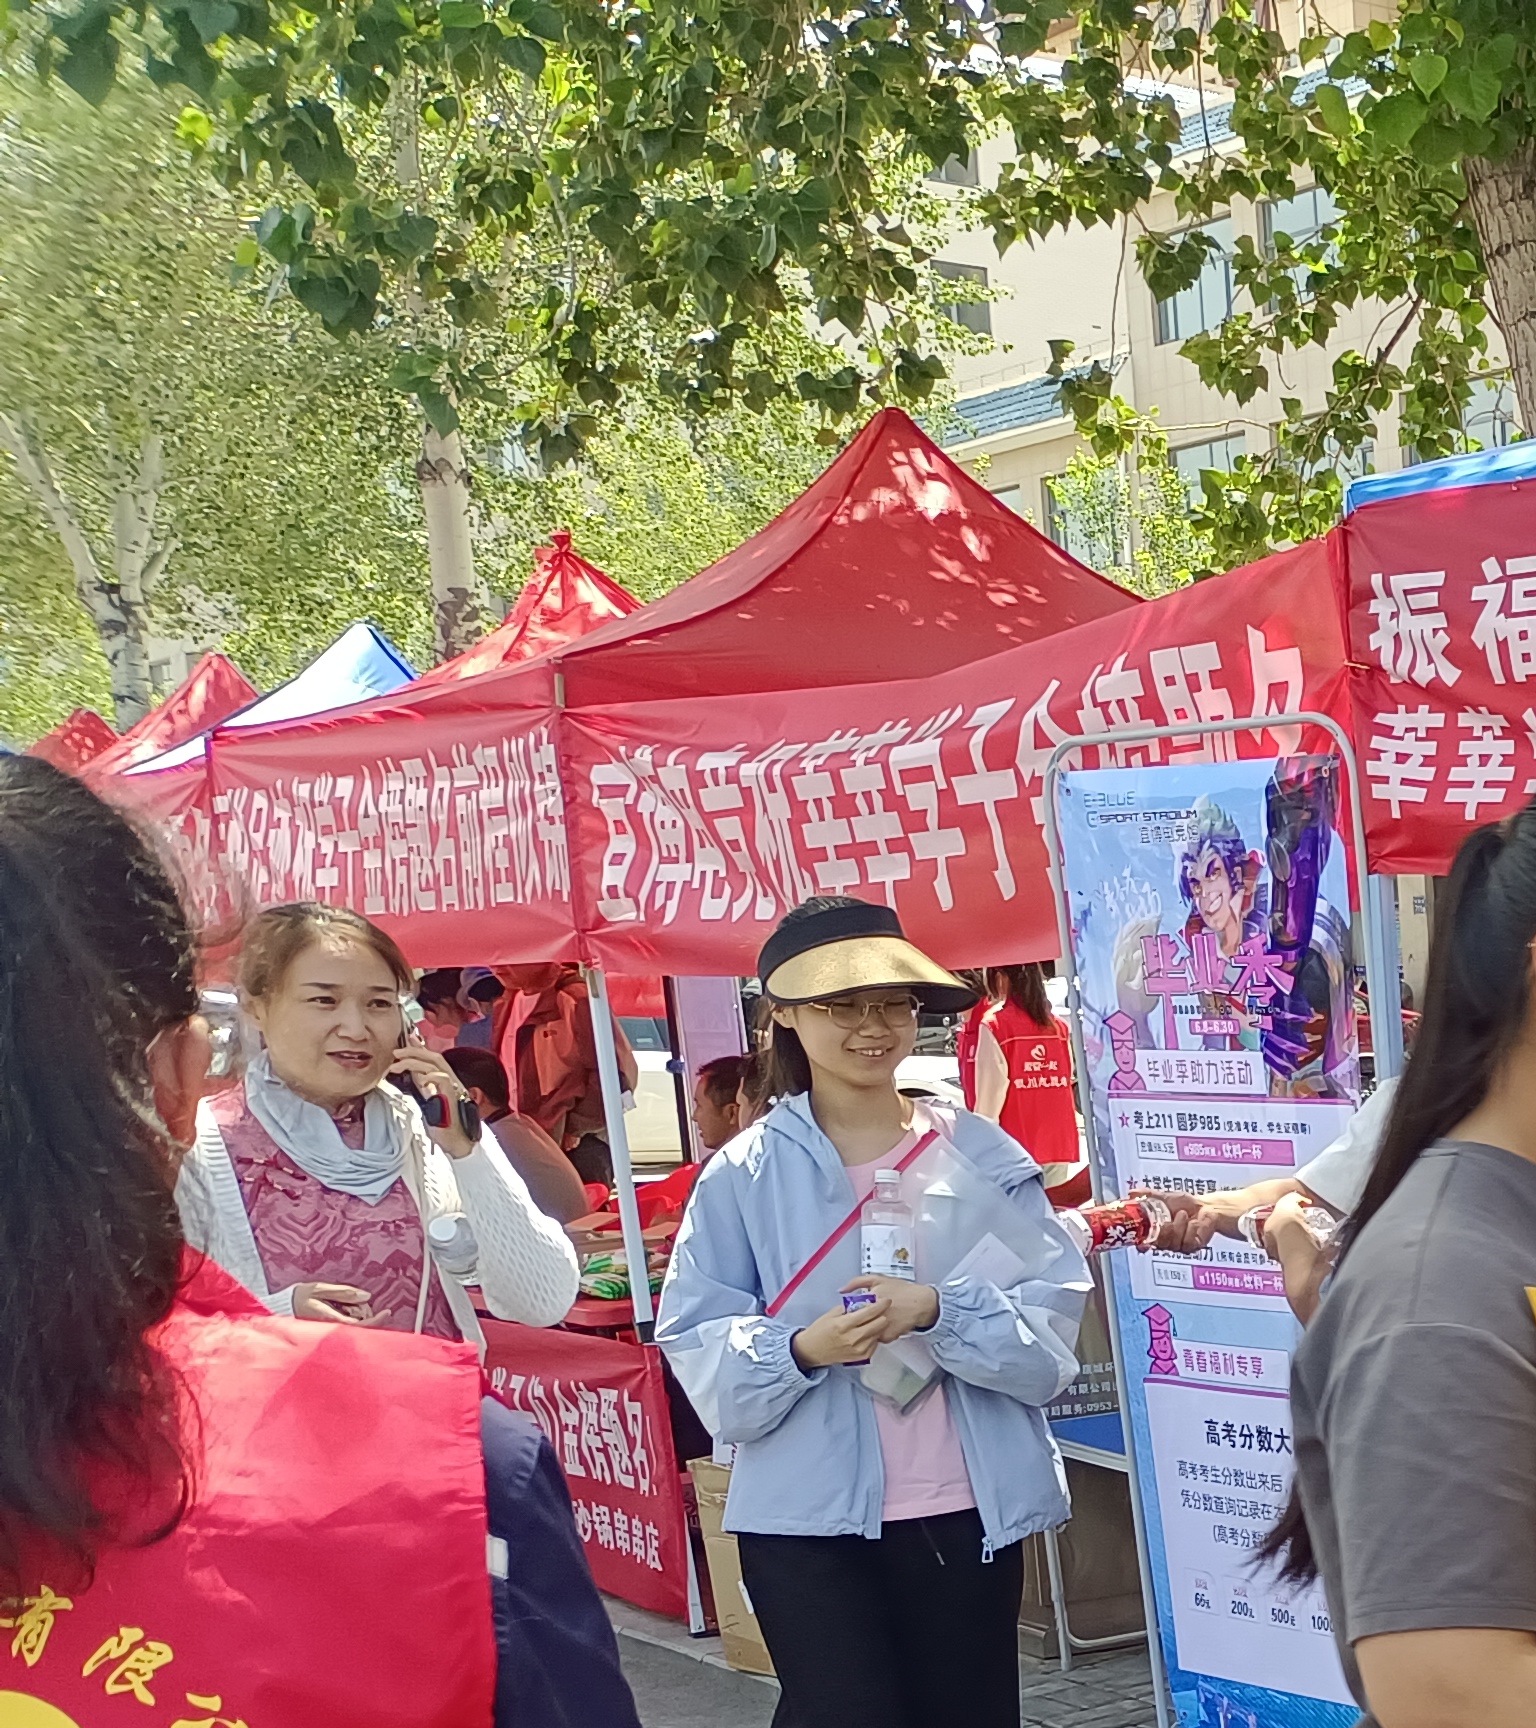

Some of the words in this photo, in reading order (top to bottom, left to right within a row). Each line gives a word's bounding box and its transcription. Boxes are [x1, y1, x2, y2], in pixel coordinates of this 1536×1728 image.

[1146, 1057, 1254, 1087] 毕业季助力活动
[1182, 1348, 1264, 1379] 青春福利专享
[1203, 1418, 1293, 1455] 高考分数大
